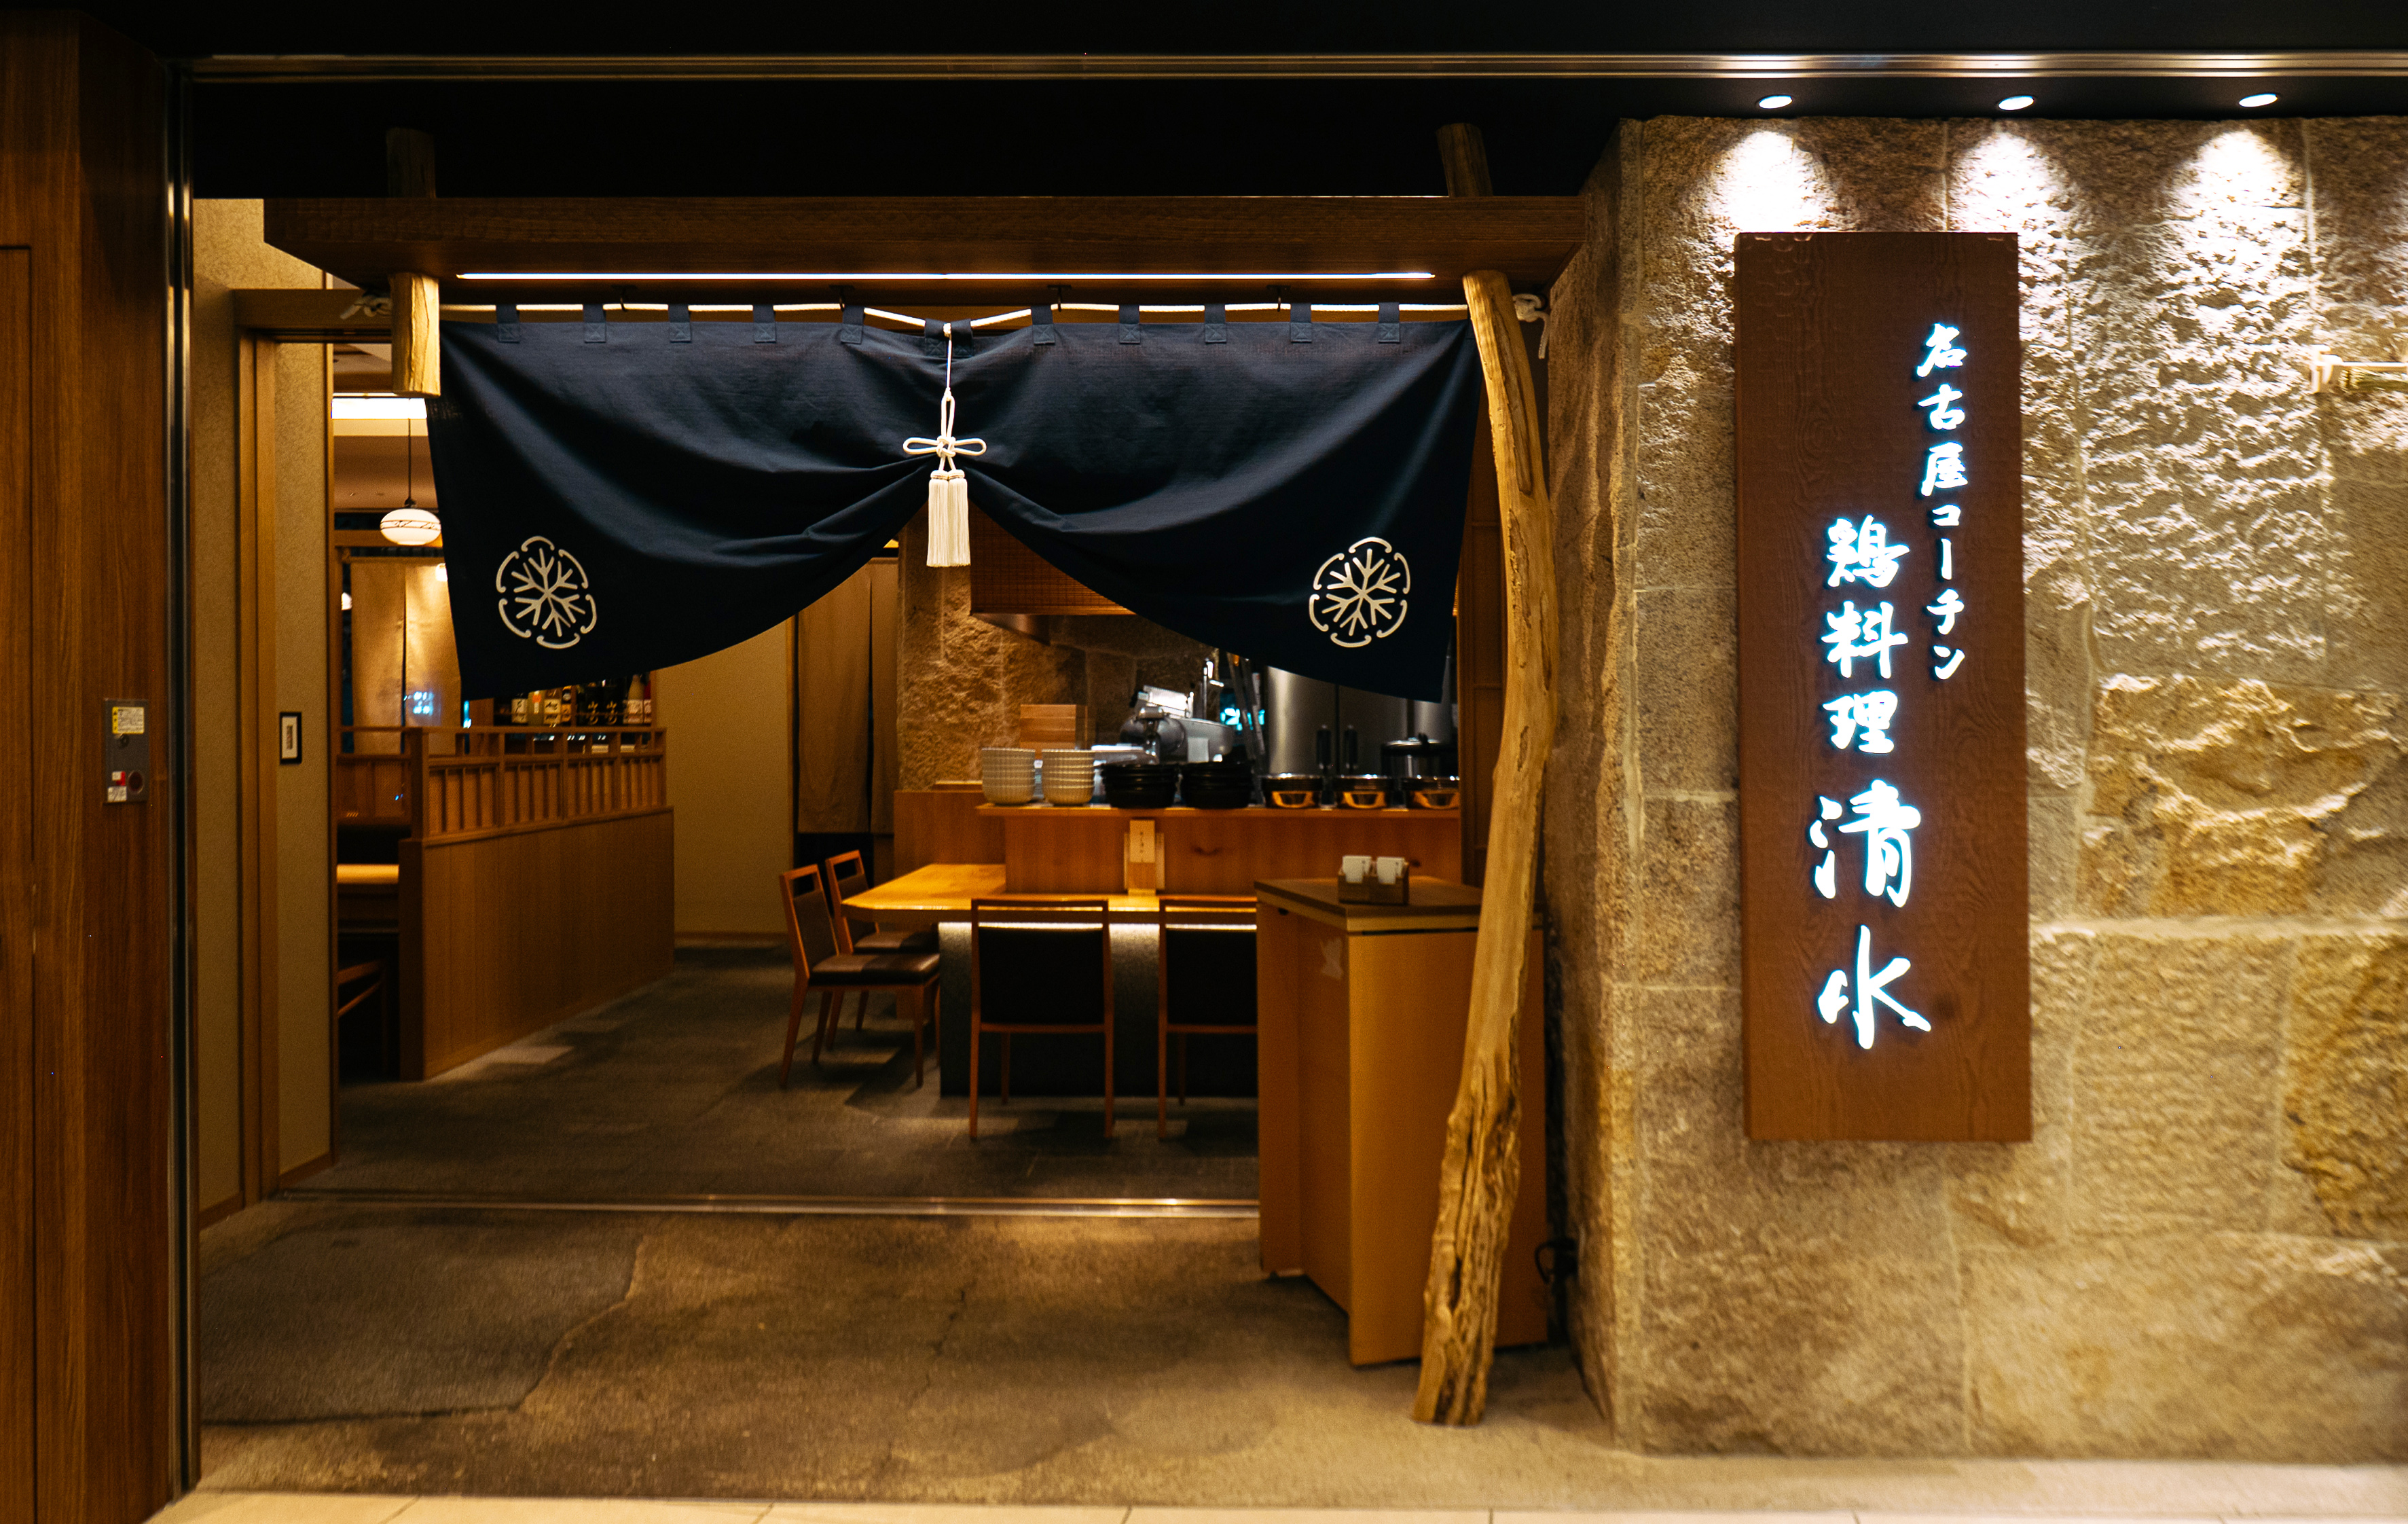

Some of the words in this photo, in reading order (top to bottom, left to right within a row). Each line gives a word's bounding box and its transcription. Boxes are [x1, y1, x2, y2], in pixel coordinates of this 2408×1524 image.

[1916, 323, 1968, 681] 名古屋コーチン
